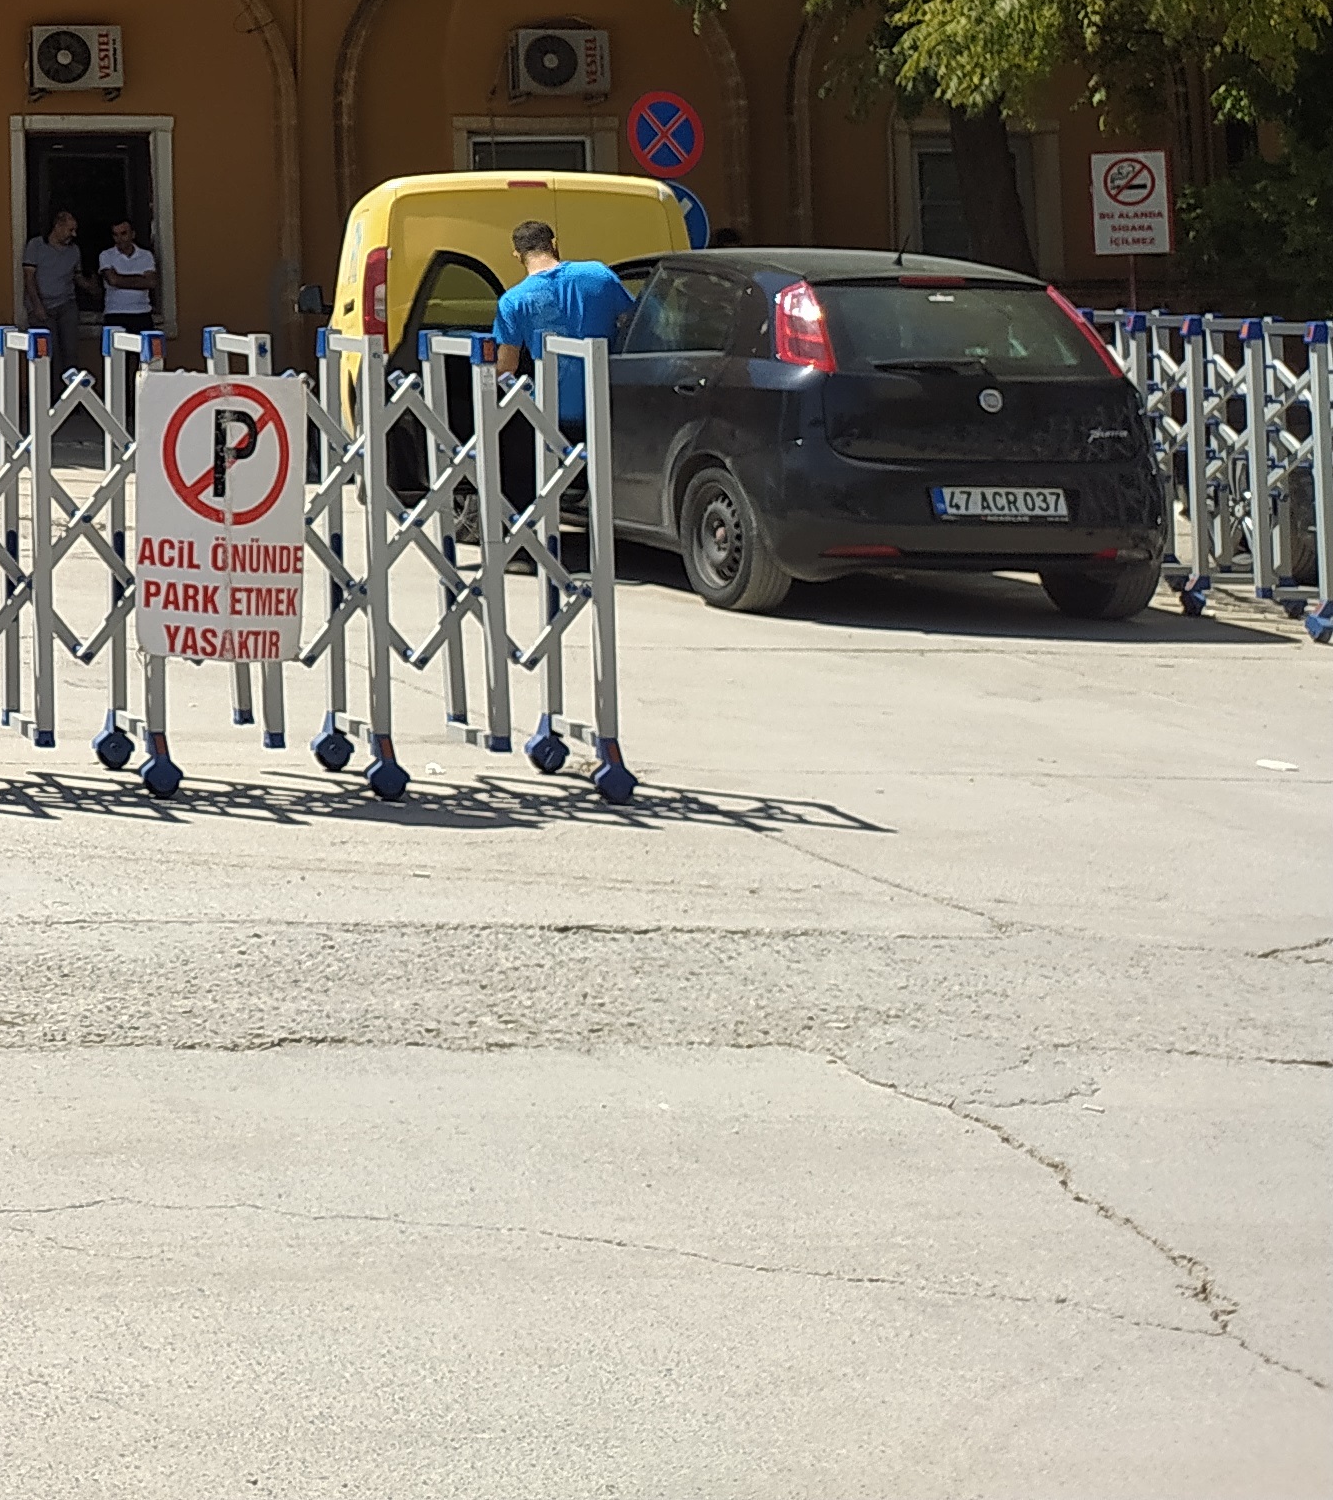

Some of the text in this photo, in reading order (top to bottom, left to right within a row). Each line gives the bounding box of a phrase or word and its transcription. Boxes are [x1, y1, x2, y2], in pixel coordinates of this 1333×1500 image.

[98, 30, 111, 79] VESTEL
[948, 490, 1061, 512] 47 ACR 037
[210, 536, 304, 575] ÖNÜNDE
[143, 579, 299, 617] PARK ETMEK
[164, 624, 281, 659] YASAKTIR
